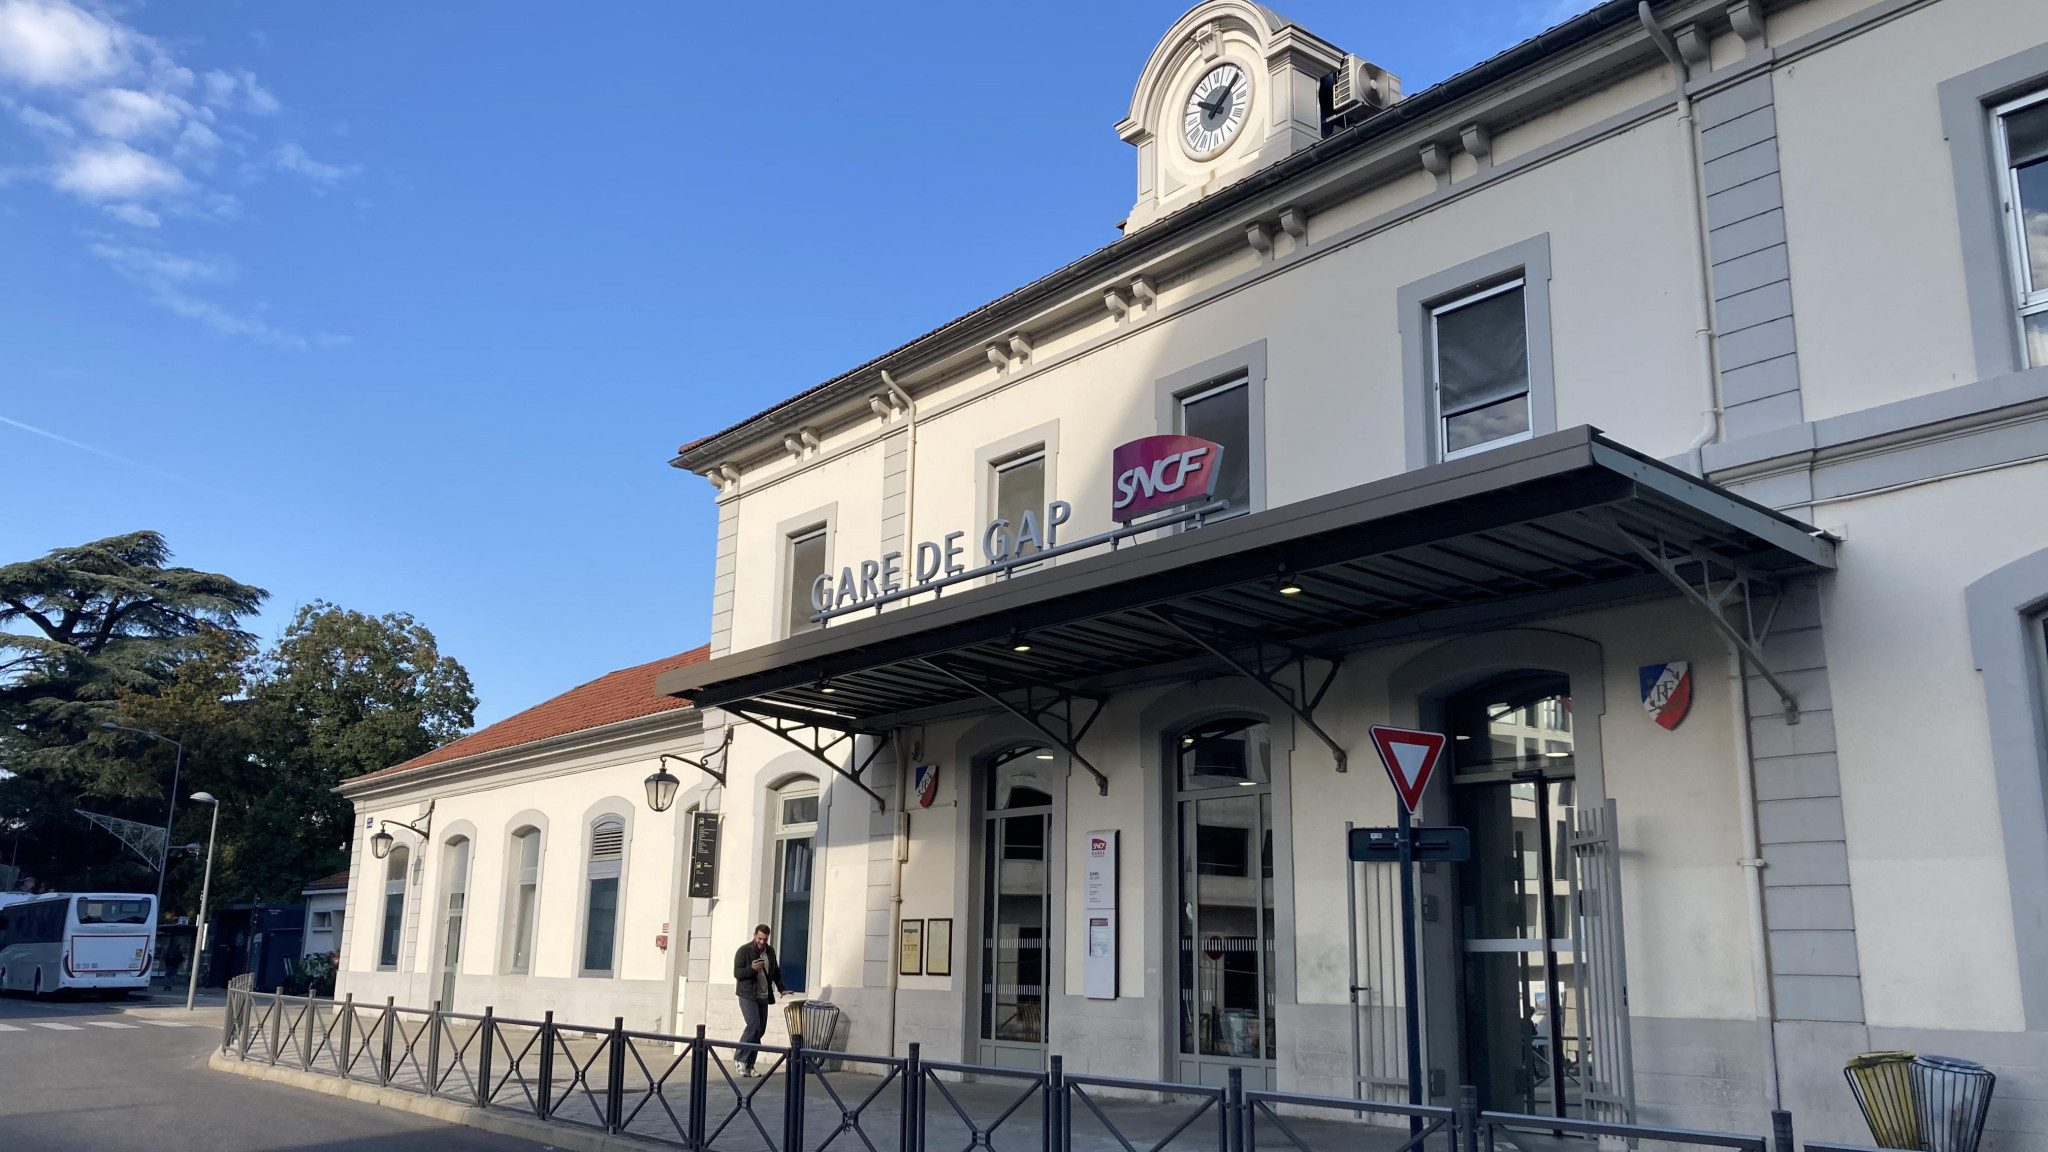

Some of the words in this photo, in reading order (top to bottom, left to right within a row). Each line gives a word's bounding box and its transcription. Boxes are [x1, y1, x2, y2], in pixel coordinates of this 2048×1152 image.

[1113, 447, 1209, 509] SNCF
[811, 551, 903, 611] GARE
[916, 531, 965, 581] DE
[983, 500, 1071, 561] GAP
[1092, 842, 1106, 850] SNCF
